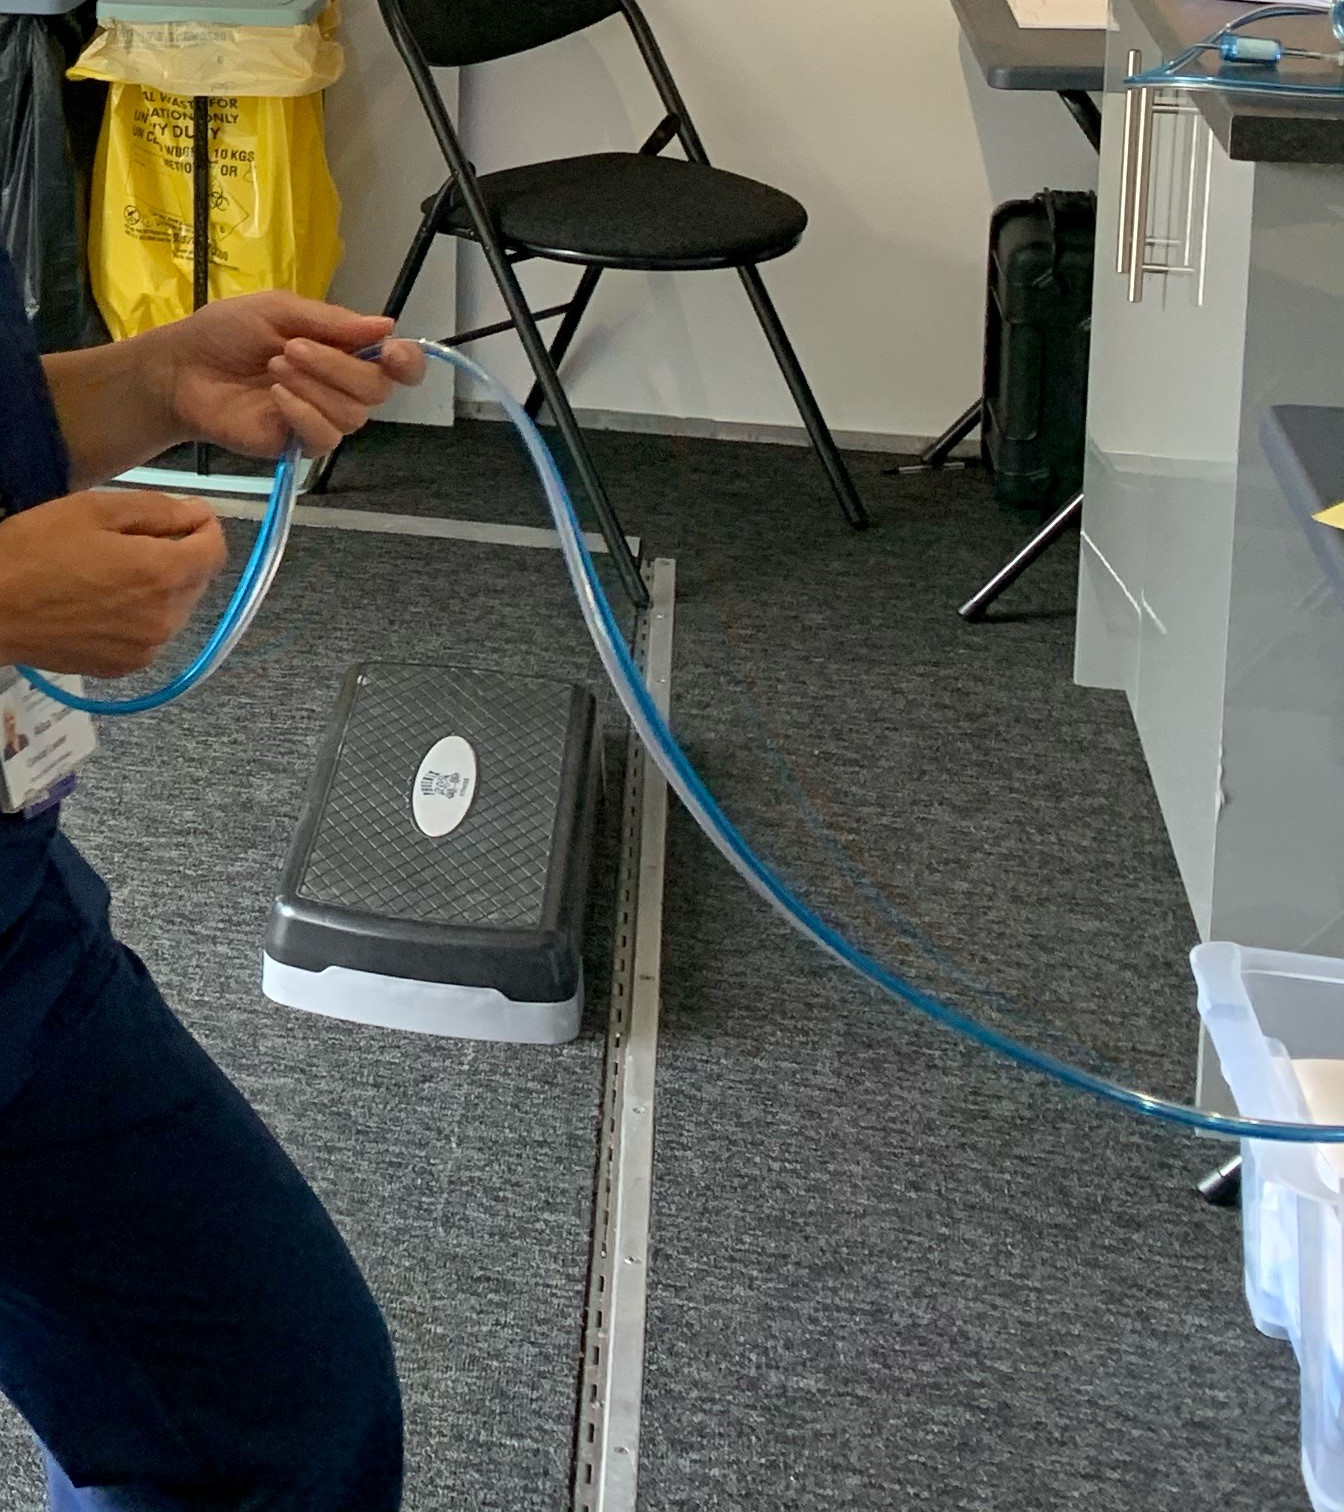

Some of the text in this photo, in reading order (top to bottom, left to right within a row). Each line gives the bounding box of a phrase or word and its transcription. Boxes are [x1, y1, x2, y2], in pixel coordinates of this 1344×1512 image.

[159, 92, 195, 110] WAST
[208, 98, 238, 110] FOR
[230, 150, 256, 163] KGS
